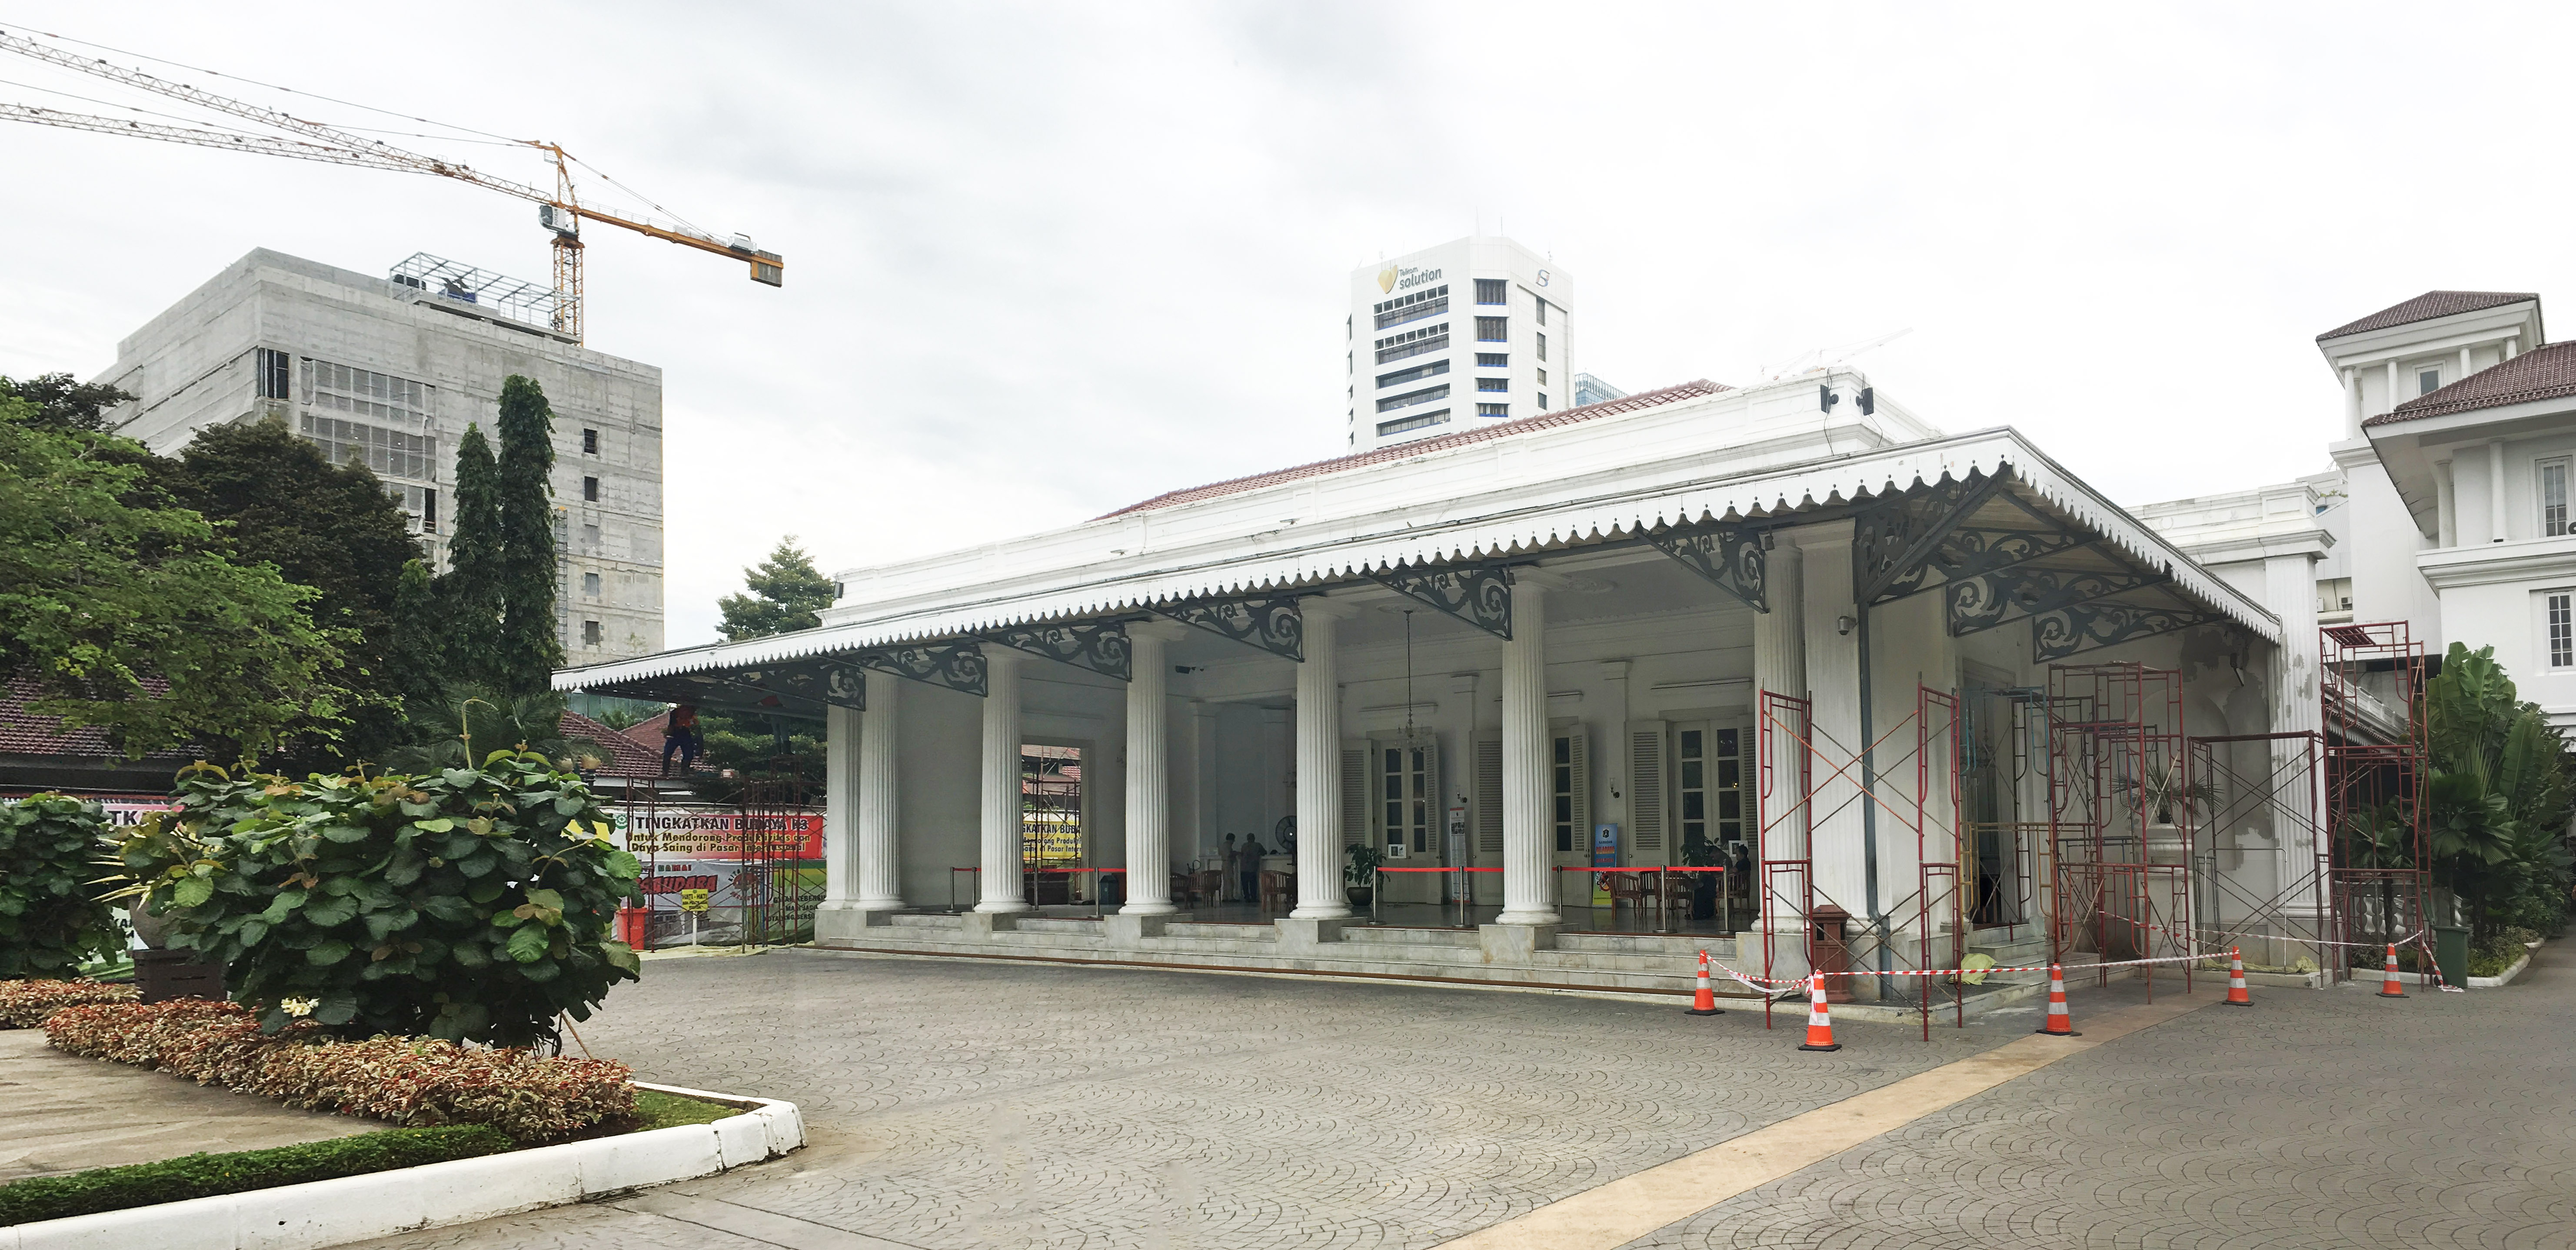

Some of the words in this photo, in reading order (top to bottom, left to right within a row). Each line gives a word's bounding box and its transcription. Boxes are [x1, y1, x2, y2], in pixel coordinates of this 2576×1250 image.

[1399, 267, 1418, 276] Telkom
[1400, 269, 1442, 290] solution
[636, 817, 729, 830] TINGKATKAN
[662, 833, 722, 843] Mendorong
[726, 833, 790, 841] Produkiitas
[632, 843, 659, 854] Daya
[663, 843, 692, 853] Saing
[696, 843, 706, 851] di
[635, 875, 718, 895] SAUDARA
